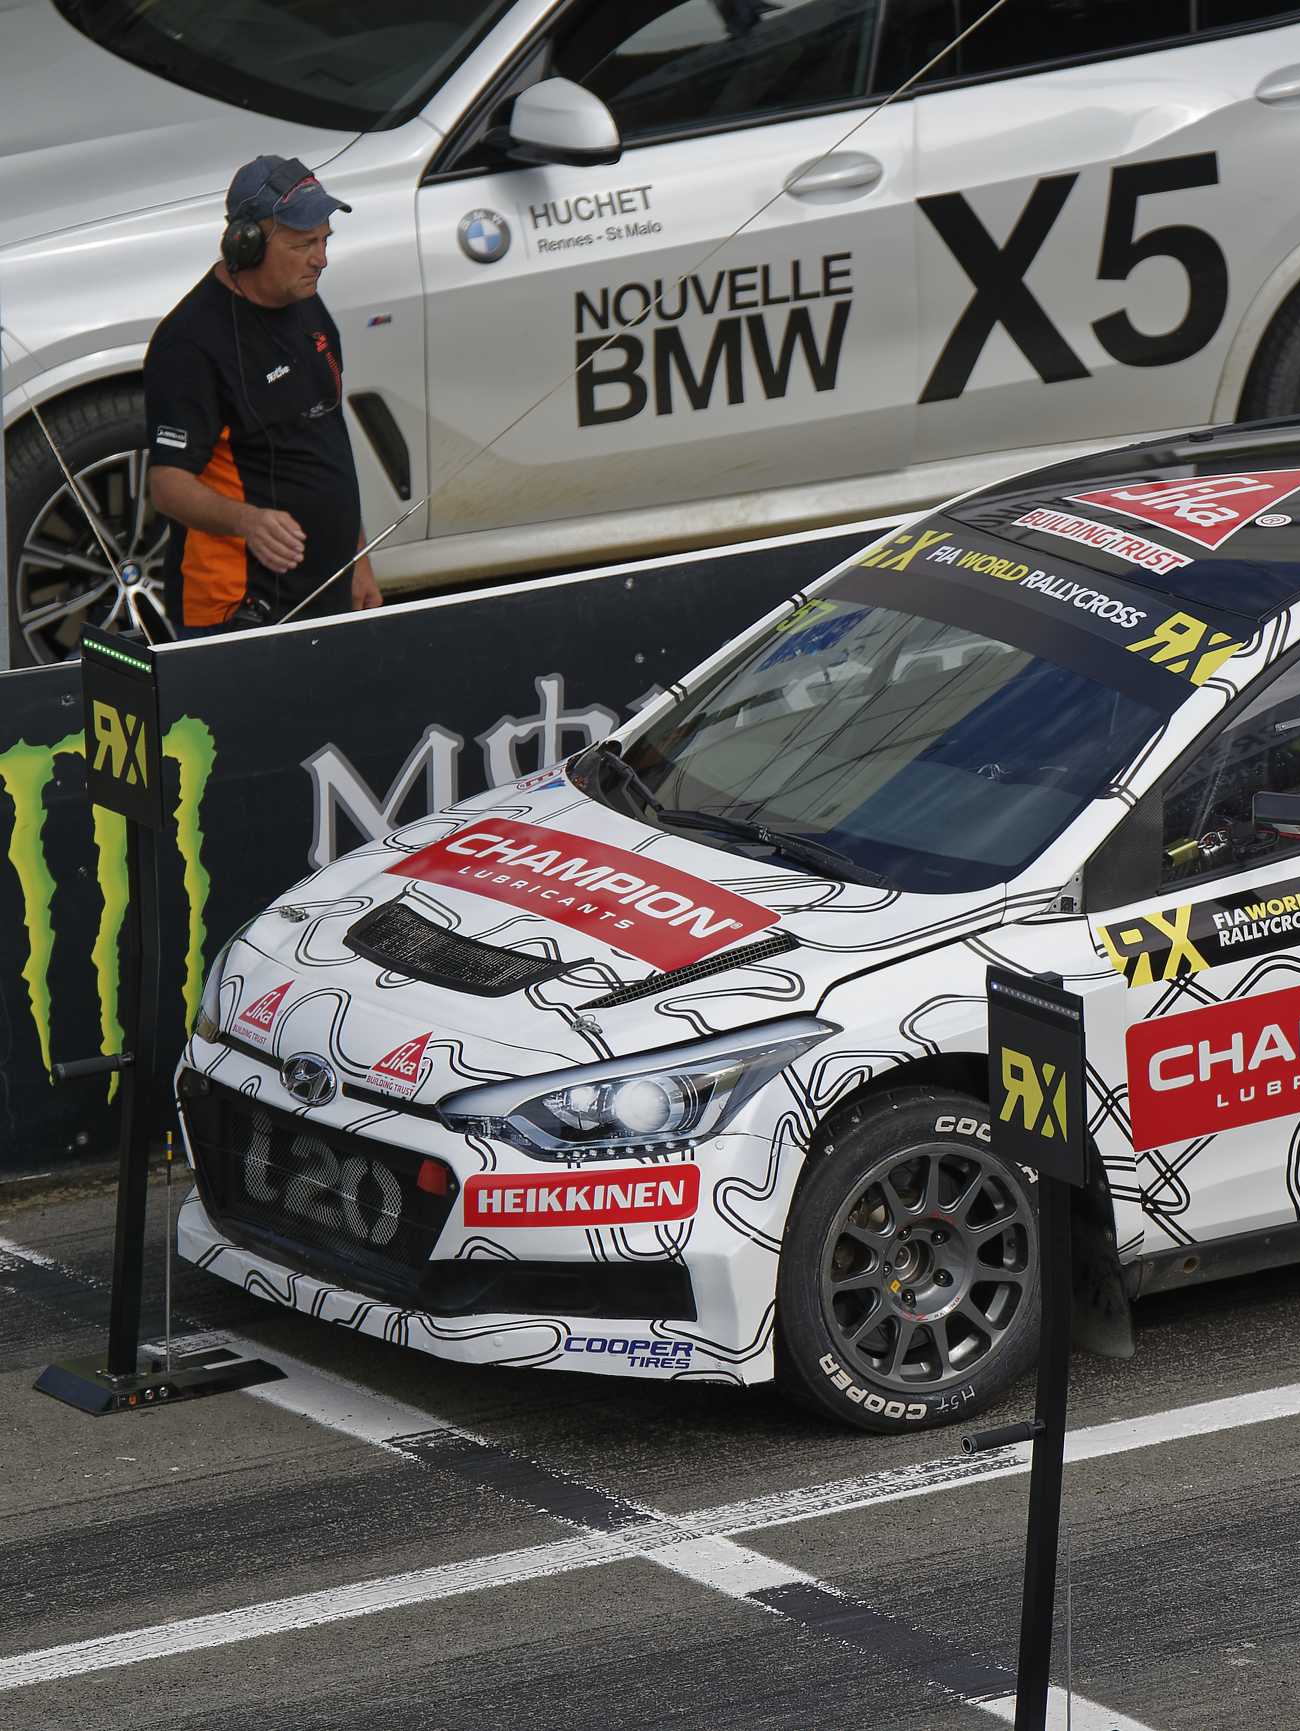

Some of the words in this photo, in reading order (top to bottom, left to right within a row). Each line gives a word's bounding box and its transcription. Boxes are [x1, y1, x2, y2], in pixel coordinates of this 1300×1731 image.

[528, 184, 653, 230] HUCHET
[537, 233, 593, 253] Rennes
[605, 226, 623, 242] St
[625, 220, 663, 238] Malo
[574, 251, 853, 334] NOUVELLE
[915, 151, 1230, 405] X5
[575, 300, 853, 429] BMW
[1110, 476, 1274, 527] Sika
[1019, 510, 1114, 546] BUILDING
[1112, 535, 1185, 571] TRUST
[926, 546, 963, 565] FIA
[956, 551, 1029, 581] WORLD
[1019, 569, 1147, 628] RALLYCROSS
[445, 833, 735, 939] CHAMPION
[458, 866, 634, 930] LUBRICANTS
[246, 991, 280, 1024] Sika
[232, 1023, 253, 1040] BUILDING
[251, 1031, 268, 1045] TRUST
[381, 1042, 421, 1076] Sika
[366, 1075, 393, 1091] BUILDING
[394, 1083, 416, 1096] TRUST
[935, 1116, 991, 1142] COO
[476, 1179, 685, 1214] HEIKKINEN
[564, 1336, 694, 1357] COOPER
[627, 1356, 691, 1369] TIRES
[819, 1353, 927, 1420] COOPER
